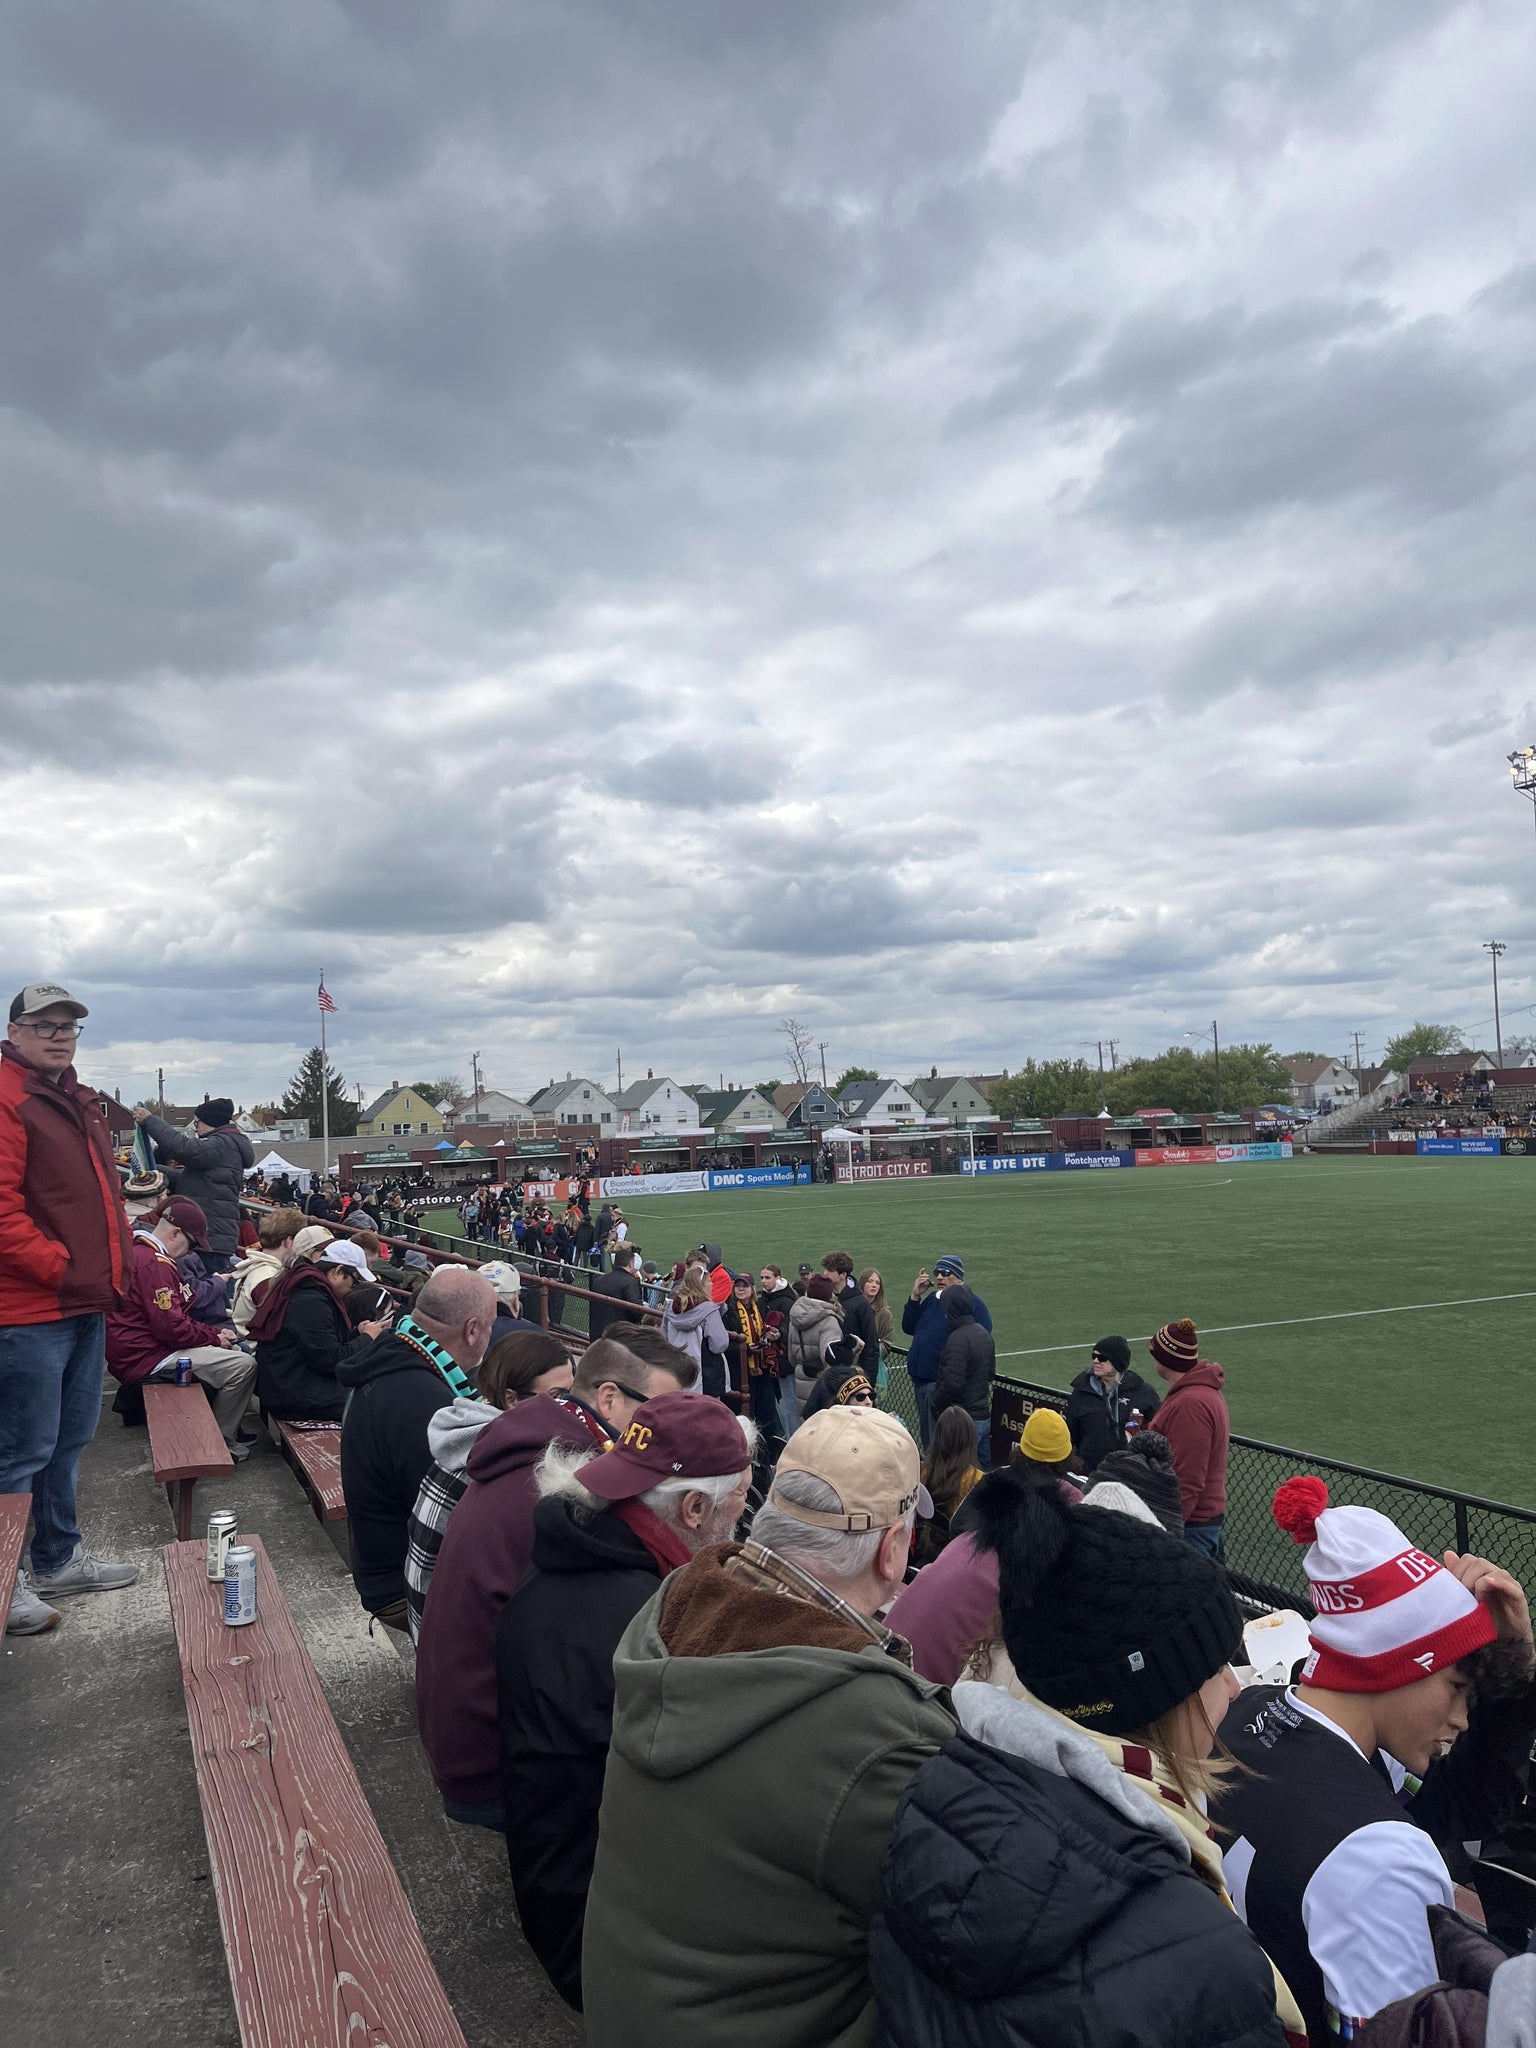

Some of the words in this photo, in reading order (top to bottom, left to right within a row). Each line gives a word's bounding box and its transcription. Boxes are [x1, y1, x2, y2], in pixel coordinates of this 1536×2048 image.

[992, 1158, 1017, 1170] DTE
[1022, 1157, 1046, 1168] DTE
[1065, 1155, 1121, 1165] Pontchartrain
[838, 1165, 883, 1179] DETROIT
[887, 1163, 911, 1176] CITY
[913, 1163, 928, 1174] FC
[610, 1179, 645, 1187] Bloomfield
[713, 1174, 744, 1186] DMC
[747, 1173, 772, 1184] Sports
[773, 1172, 808, 1182] Medicne
[528, 1183, 555, 1197] GRIT
[610, 1185, 650, 1196] Chiropractic
[651, 1184, 673, 1193] Center
[623, 1422, 653, 1451] FC
